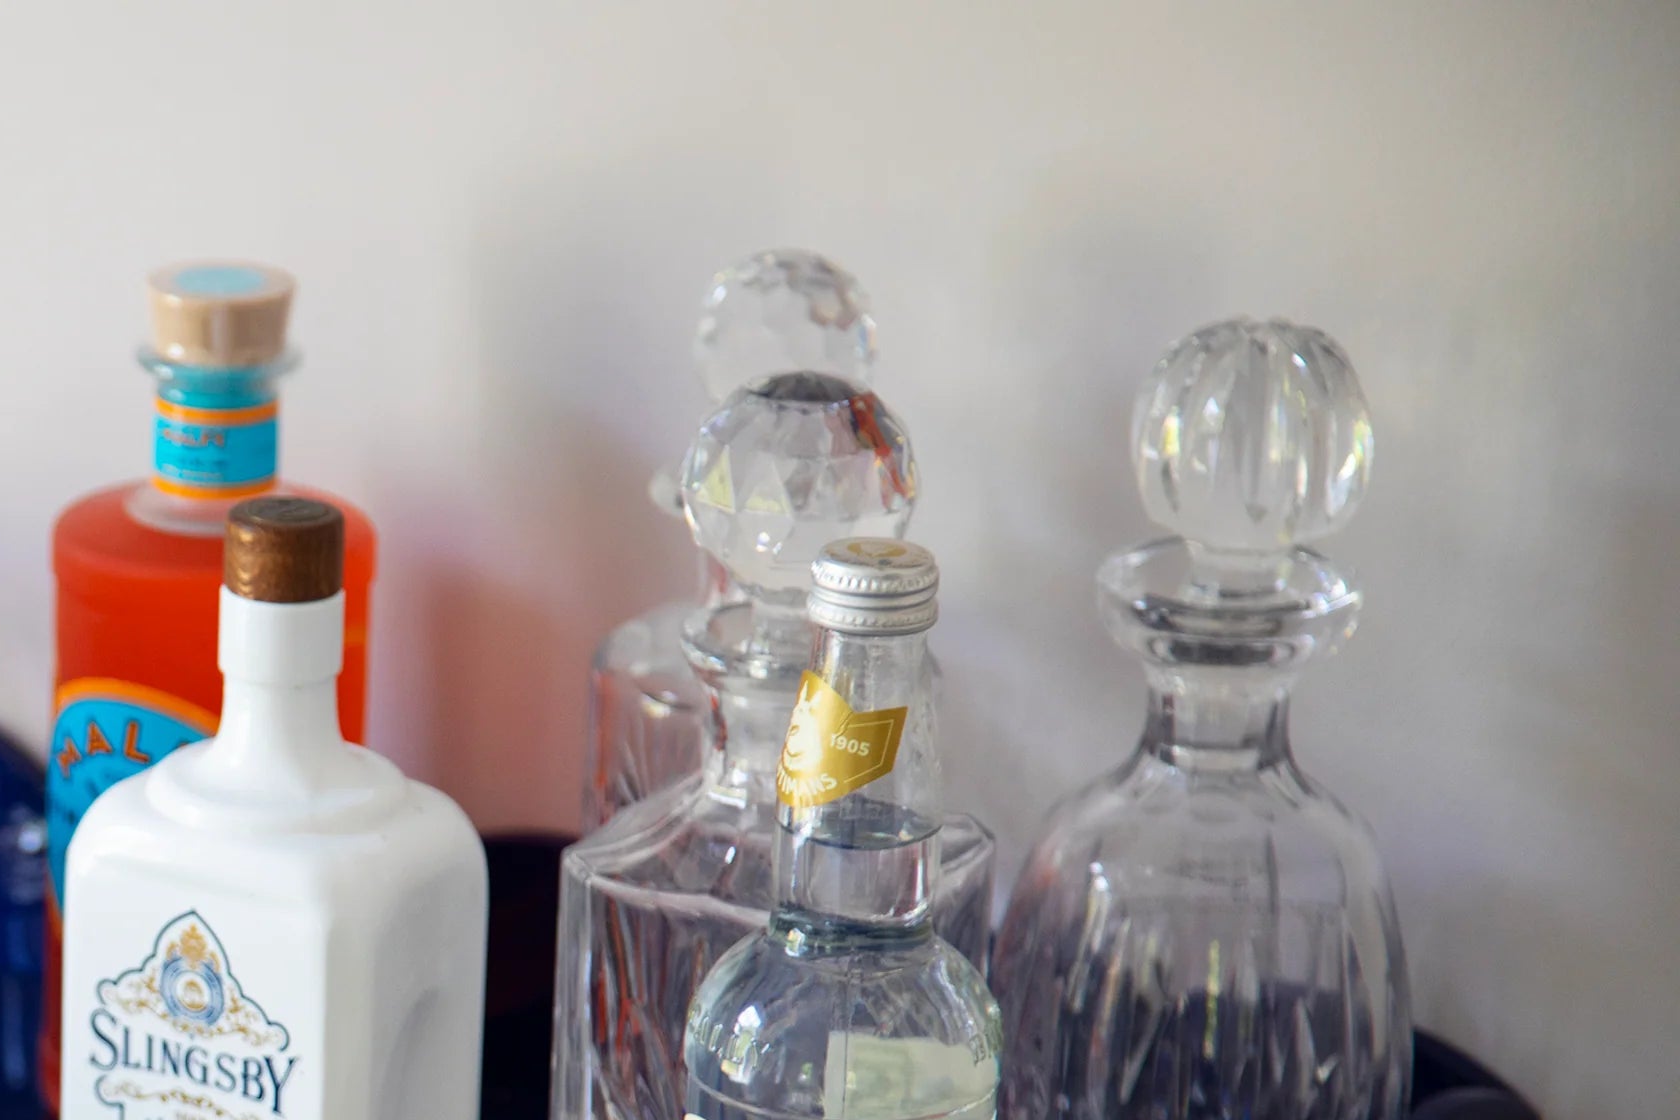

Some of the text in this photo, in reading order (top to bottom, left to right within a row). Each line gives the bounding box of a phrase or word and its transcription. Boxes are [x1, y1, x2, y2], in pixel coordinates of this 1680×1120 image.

[56, 719, 190, 780] MAL
[830, 733, 871, 757] 1905
[90, 1007, 299, 1113] SLINGSBY
